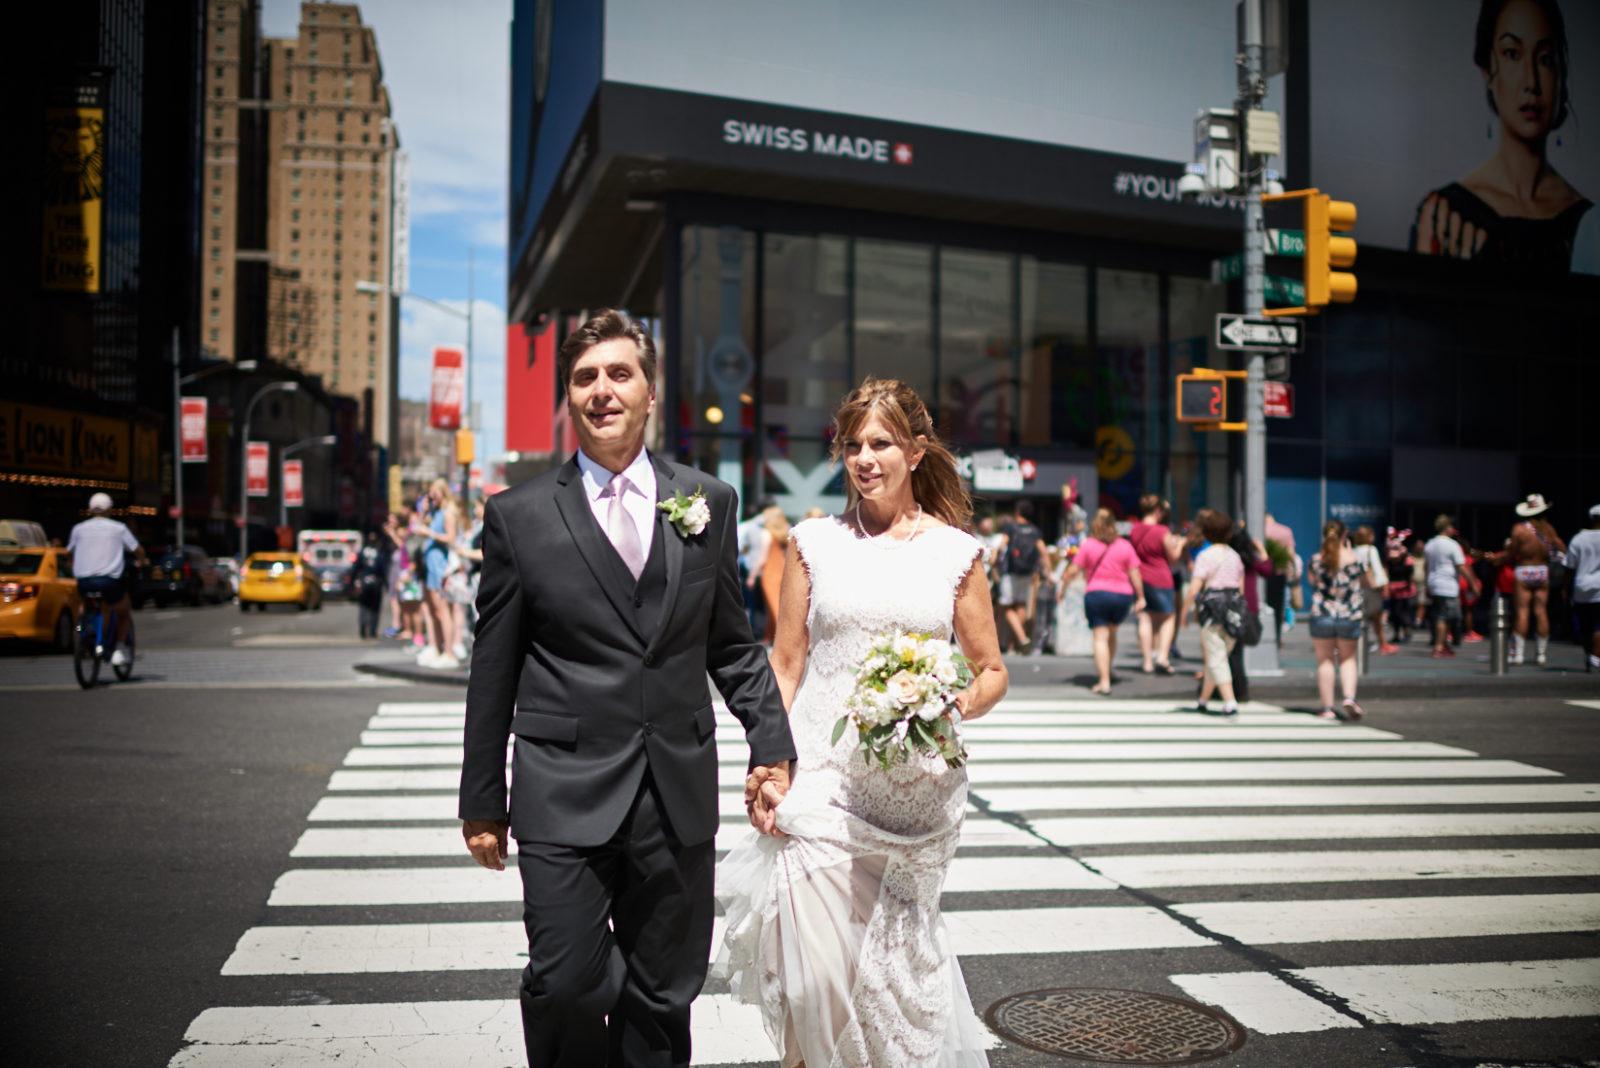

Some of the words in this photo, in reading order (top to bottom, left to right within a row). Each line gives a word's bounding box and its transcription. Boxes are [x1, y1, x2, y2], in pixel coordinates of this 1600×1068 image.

[723, 119, 808, 151] SWISS
[813, 132, 889, 162] MADE
[15, 407, 64, 464] LION
[72, 416, 117, 468] KING
